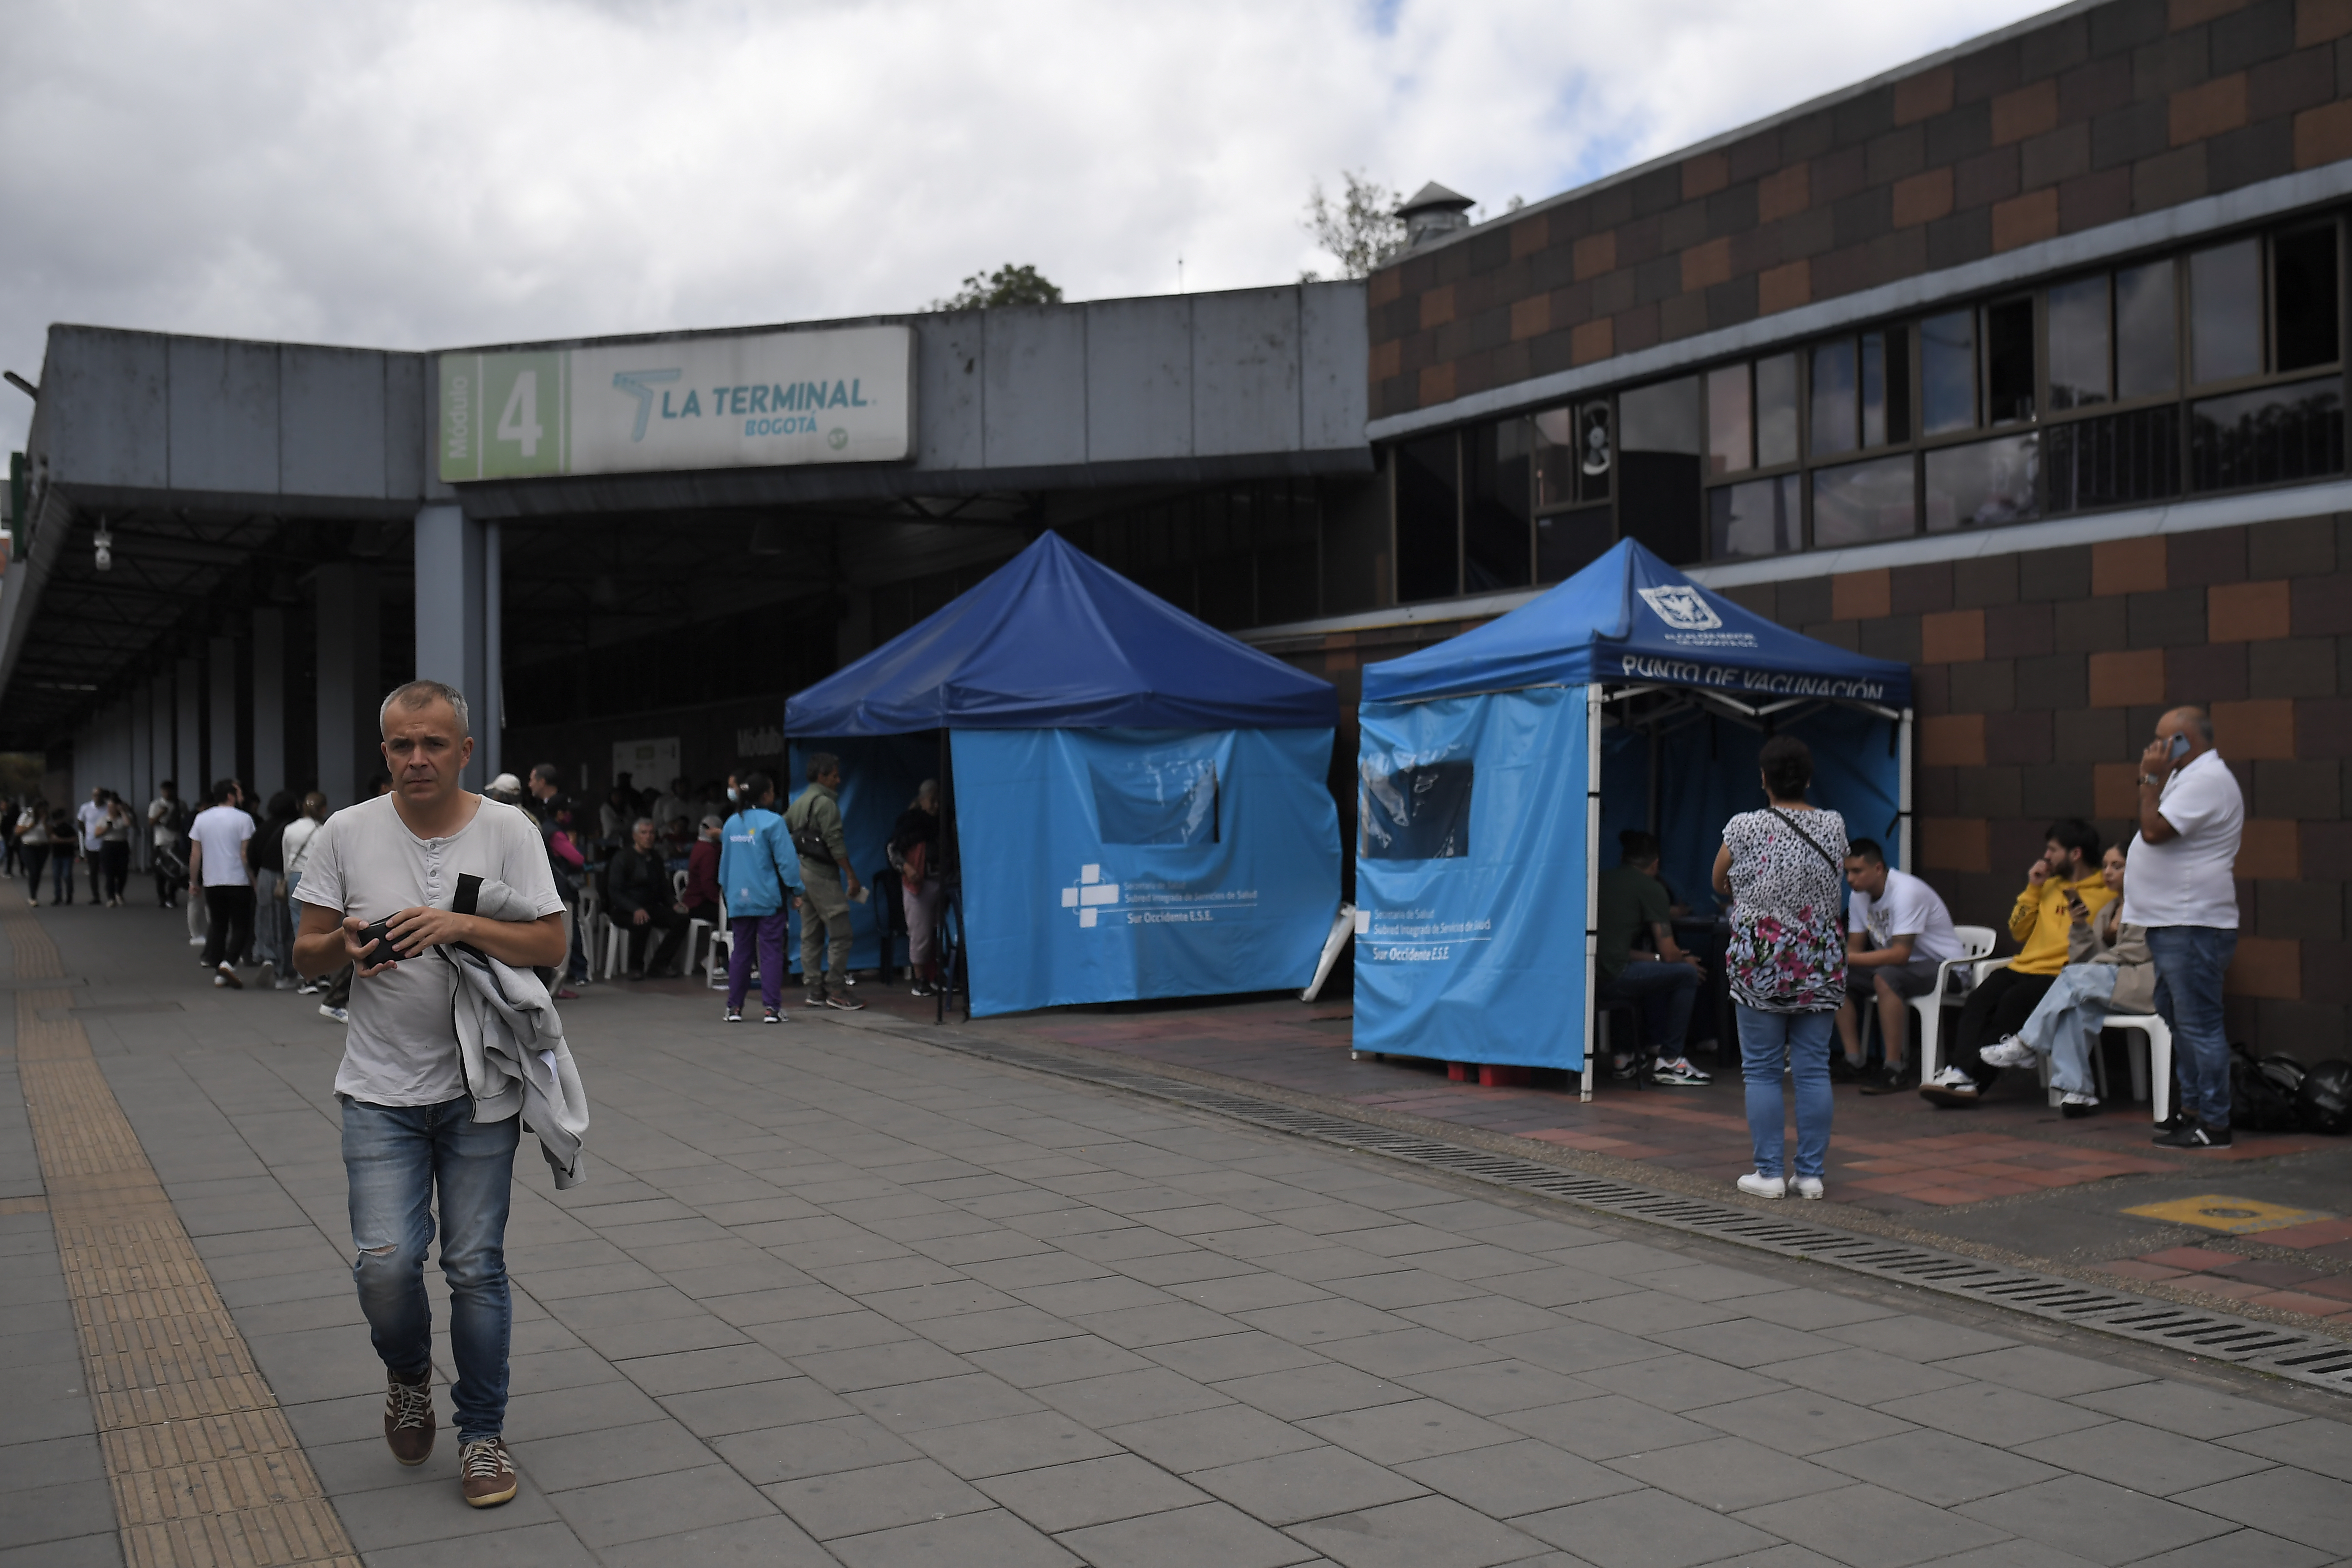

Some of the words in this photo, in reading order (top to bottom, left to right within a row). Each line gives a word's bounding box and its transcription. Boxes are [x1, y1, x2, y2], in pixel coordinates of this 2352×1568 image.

[447, 376, 468, 459] Módulo
[497, 370, 543, 457] 4
[662, 389, 702, 419] LA
[713, 378, 868, 416] TERMINAL
[745, 410, 817, 437] BOGOTÁ
[1622, 655, 1700, 682] PUNTO
[1743, 670, 1884, 700] VACUNACIÓN
[1127, 912, 1142, 924] Sur
[1144, 911, 1188, 923] Occidente
[1373, 947, 1388, 960] Sur
[1389, 947, 1431, 961] Occidente
